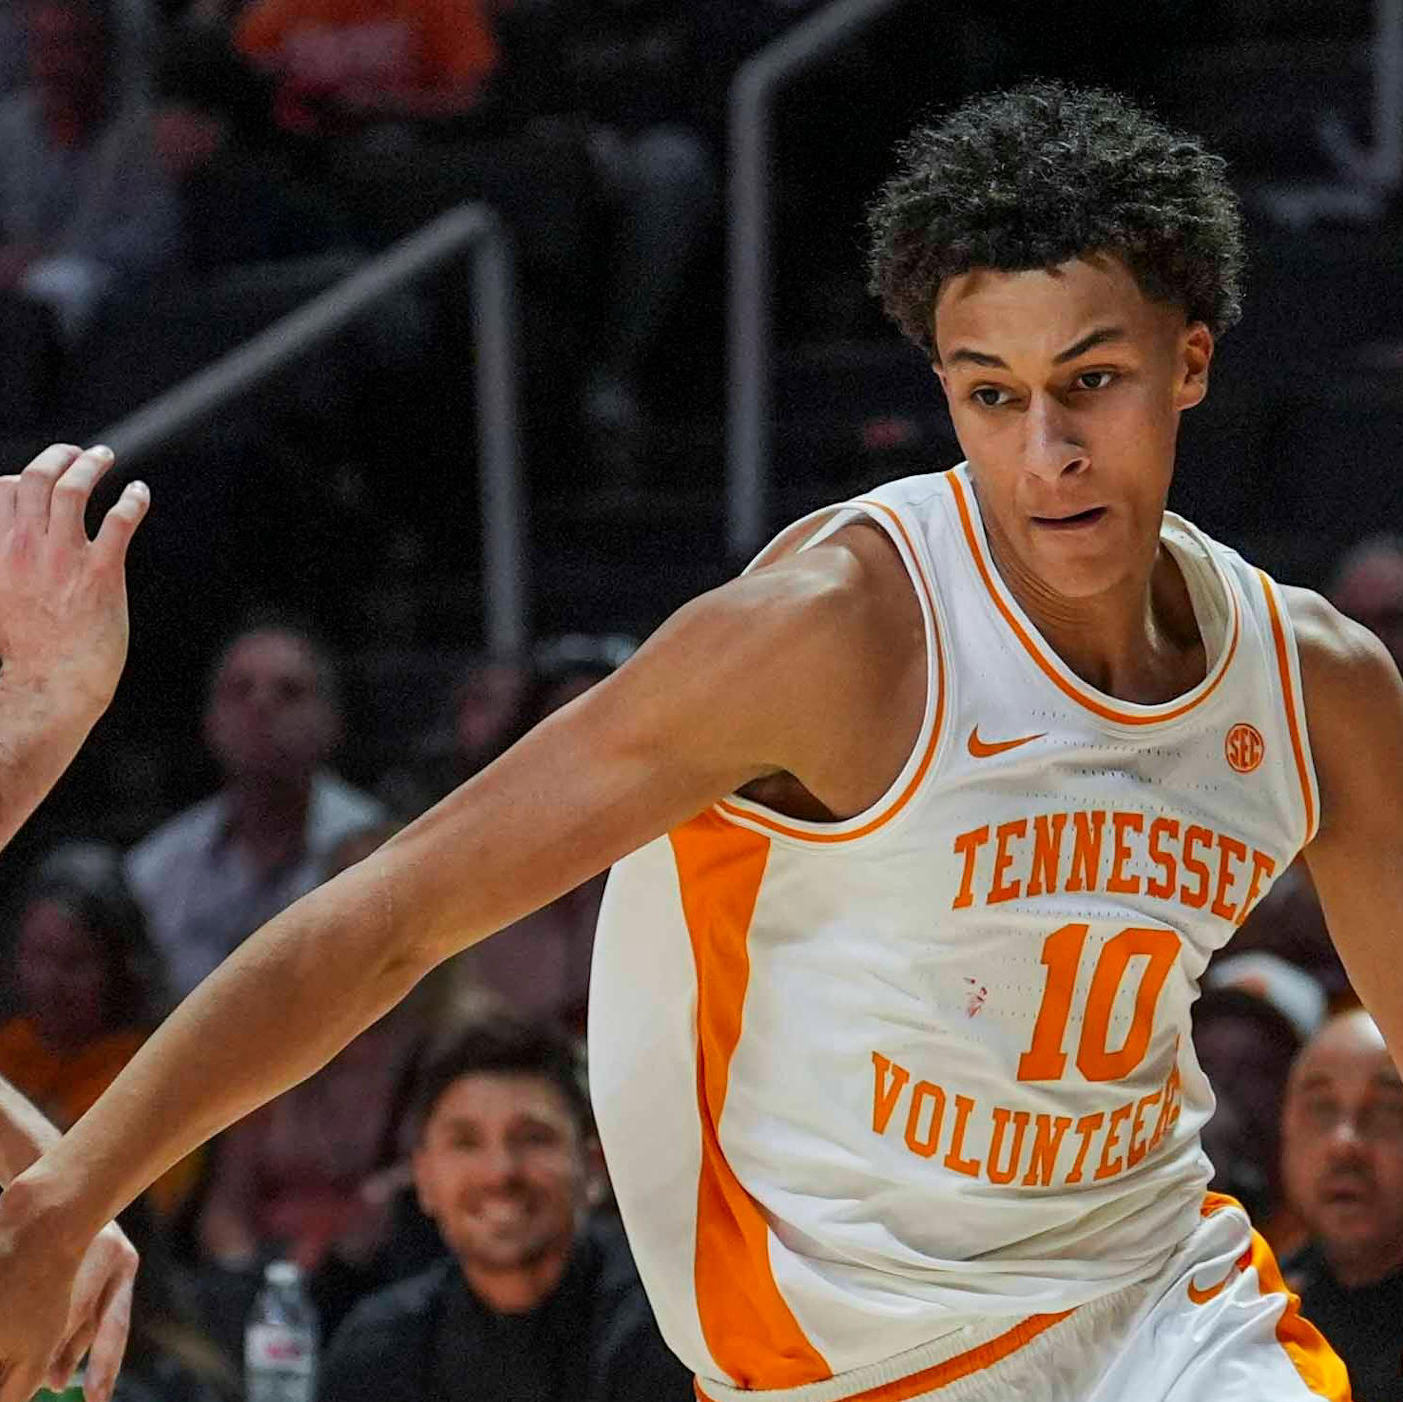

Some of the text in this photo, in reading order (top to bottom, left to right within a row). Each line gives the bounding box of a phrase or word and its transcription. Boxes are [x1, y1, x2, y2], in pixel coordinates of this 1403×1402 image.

[1228, 727, 1260, 768] SEC
[952, 809, 1276, 926] TENNESSEE
[1016, 923, 1182, 1082] 10
